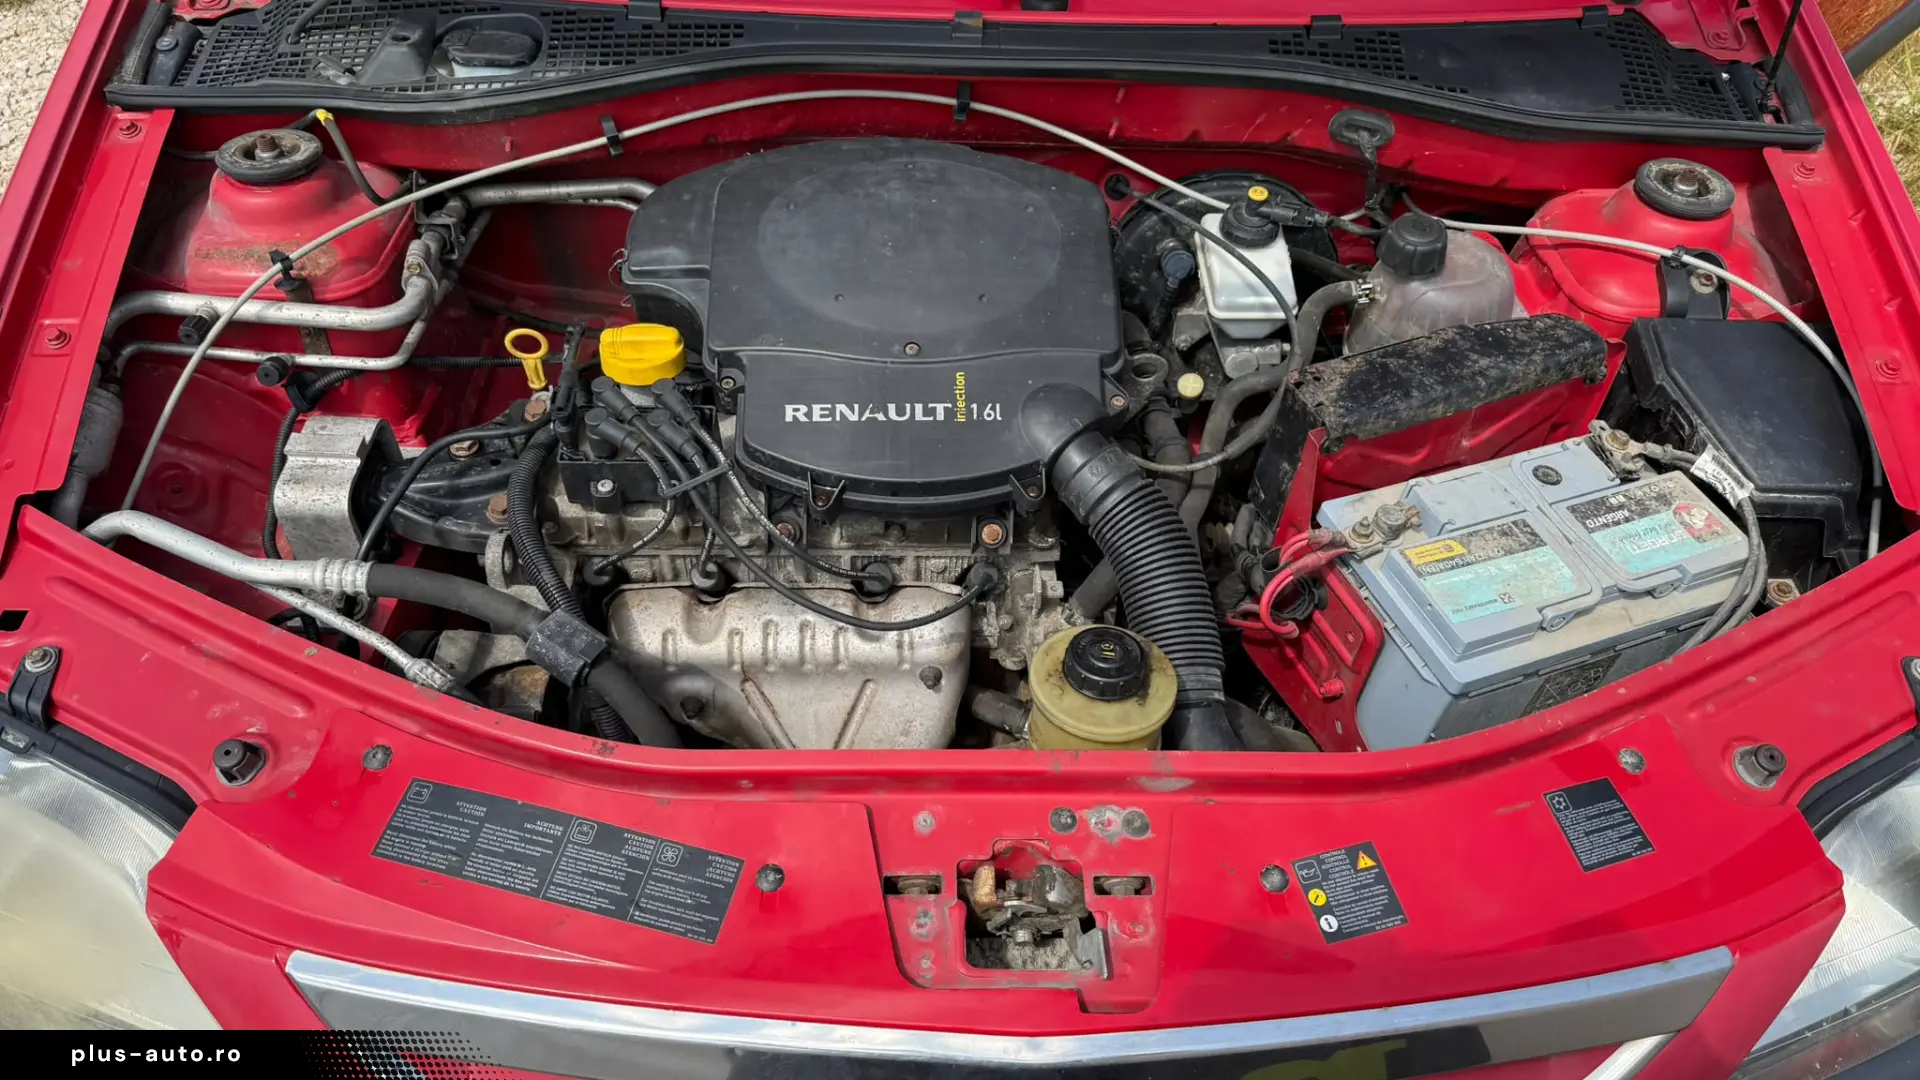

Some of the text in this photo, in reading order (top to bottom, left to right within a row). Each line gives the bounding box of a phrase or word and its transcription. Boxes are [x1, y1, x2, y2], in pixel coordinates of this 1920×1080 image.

[954, 371, 967, 422] injection
[784, 403, 952, 422] RENAULT
[1585, 508, 1630, 528] ARGENTO
[456, 801, 487, 812] ATTENTION
[460, 807, 485, 817] CAUTION
[524, 822, 562, 836] IMPORTANTE
[536, 820, 564, 831] ACHTUNG
[623, 832, 656, 845] ATTENTION
[628, 839, 654, 850] CAUTION
[624, 844, 652, 855] ACHTUNG
[707, 854, 739, 867] ATTENTION
[707, 866, 735, 878] ACHTUNG
[712, 861, 737, 873] CAUTION
